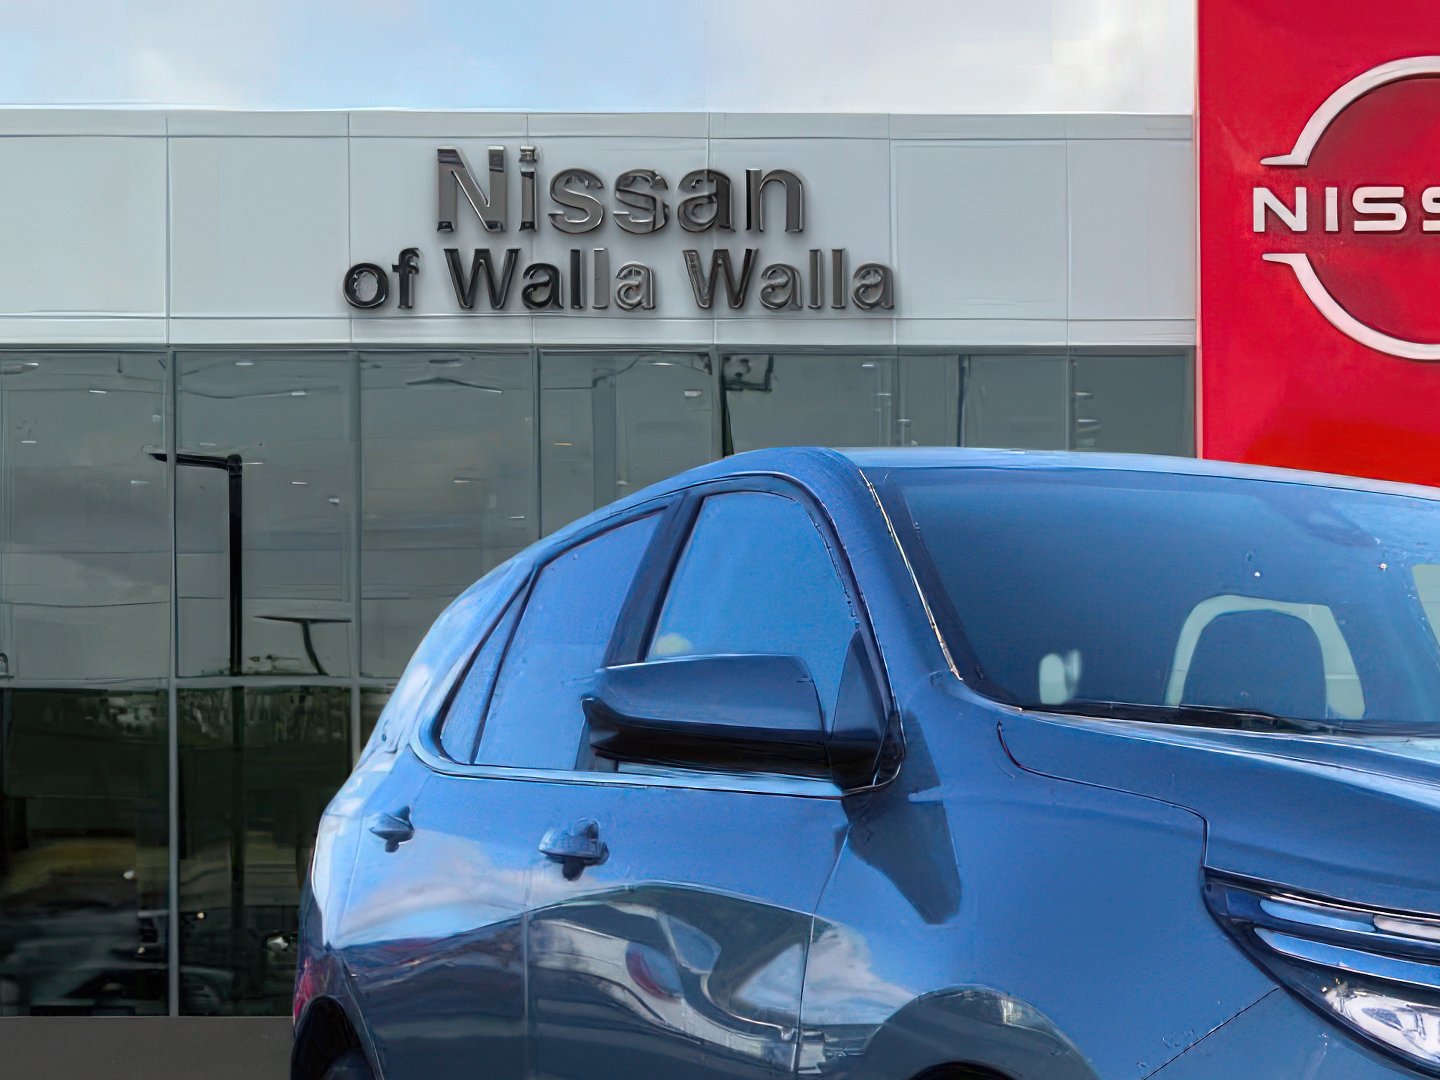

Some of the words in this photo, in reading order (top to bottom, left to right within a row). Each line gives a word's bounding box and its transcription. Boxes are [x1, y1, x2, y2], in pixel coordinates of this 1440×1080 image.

[435, 144, 806, 235] Nissan
[342, 247, 421, 310] of
[443, 247, 657, 311] Walla
[681, 247, 895, 311] Walla
